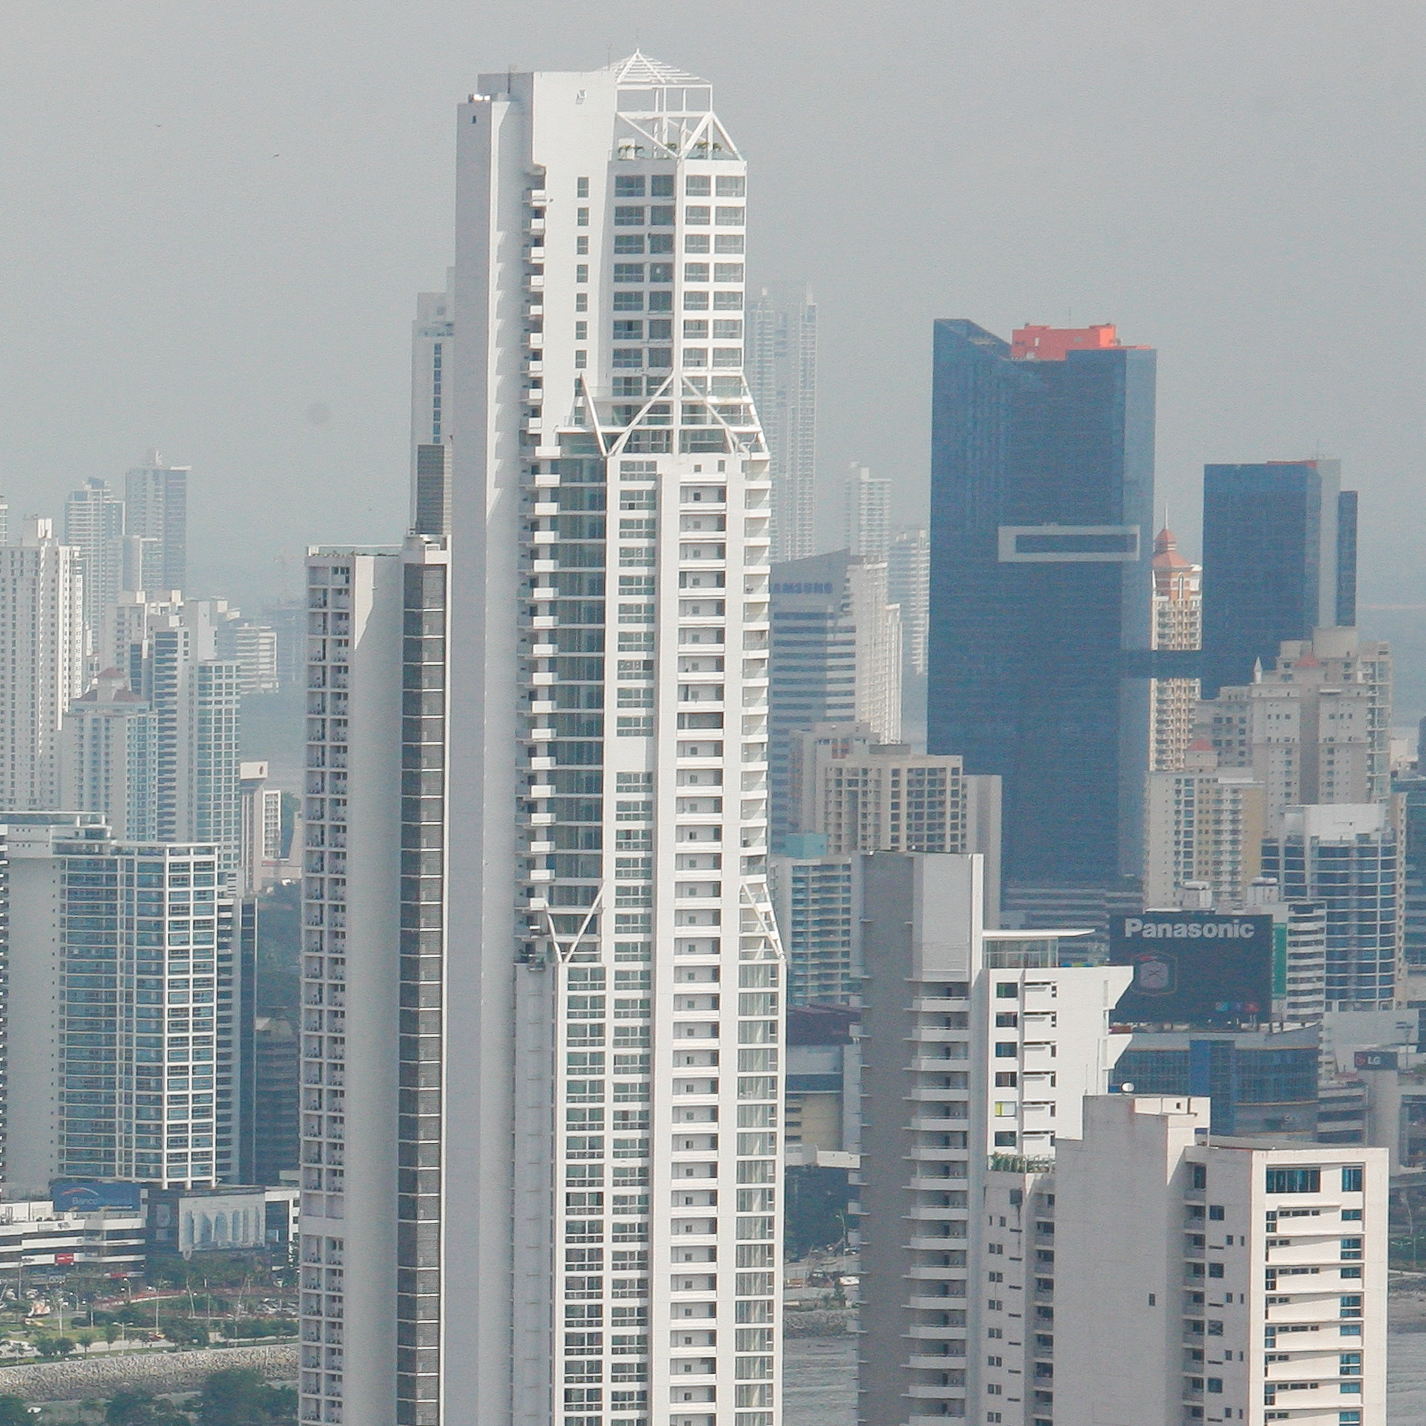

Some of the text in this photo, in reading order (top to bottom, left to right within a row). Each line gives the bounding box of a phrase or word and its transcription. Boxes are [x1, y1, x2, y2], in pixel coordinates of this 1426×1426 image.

[771, 582, 834, 594] AMSUNG
[1124, 917, 1255, 939] Panasonic
[1367, 1056, 1381, 1065] LG
